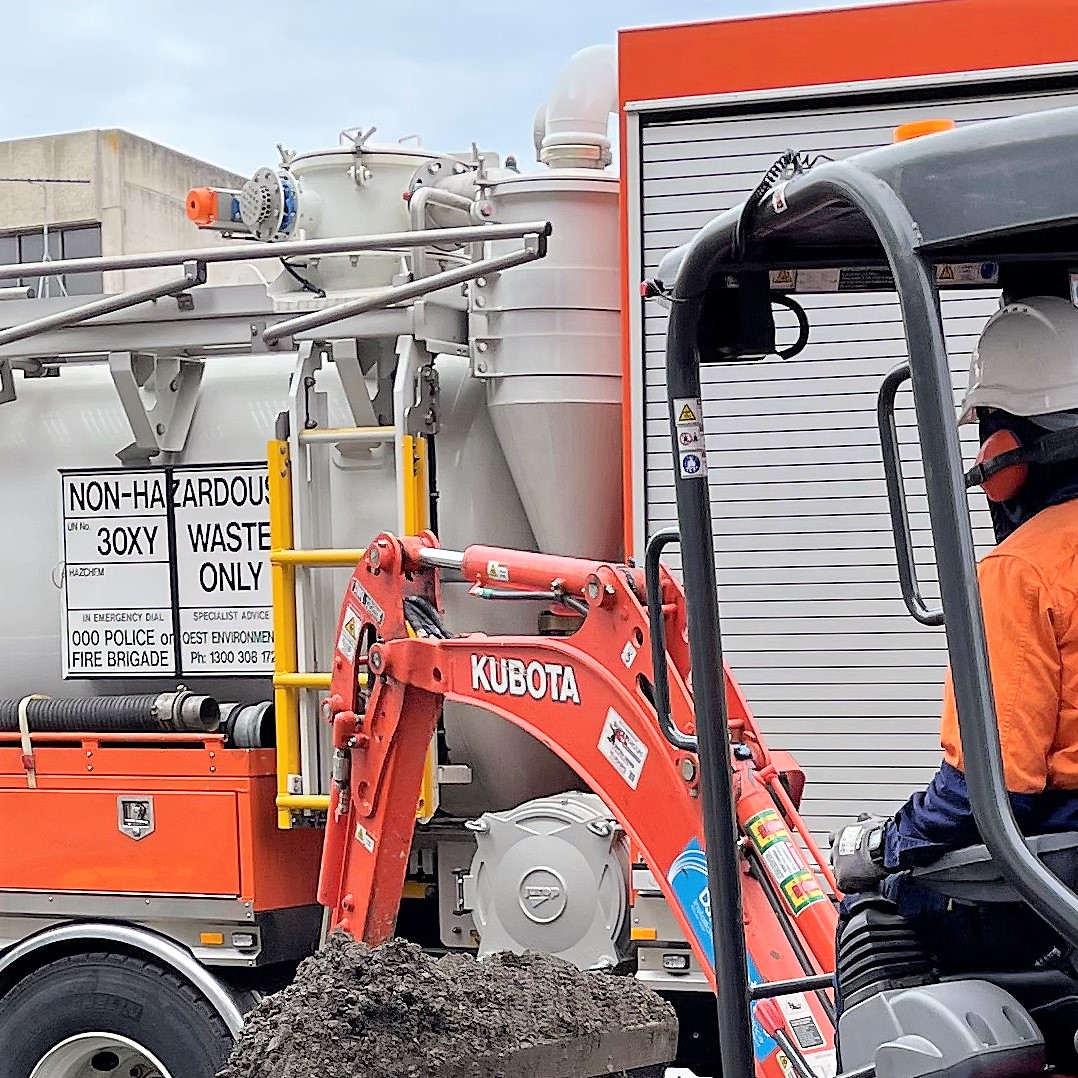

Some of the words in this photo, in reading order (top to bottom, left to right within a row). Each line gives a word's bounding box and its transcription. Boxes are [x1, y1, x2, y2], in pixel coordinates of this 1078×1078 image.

[97, 526, 158, 555] 30XY
[187, 521, 271, 552] WASTE
[69, 567, 104, 577] HAZCHEM
[200, 562, 263, 592] ONLY
[83, 614, 91, 622] IN
[94, 613, 143, 622] EMERGENCY
[145, 612, 164, 621] DIAL
[193, 611, 238, 621] SPECIALIST
[241, 610, 269, 620] ADVICE
[104, 629, 155, 646] POLICE
[160, 633, 174, 645] or
[73, 651, 102, 667] FIRE
[107, 650, 169, 667] BRIGADE
[210, 651, 235, 663] 1300
[238, 651, 258, 663] 308
[470, 653, 581, 704] KUBOTA
